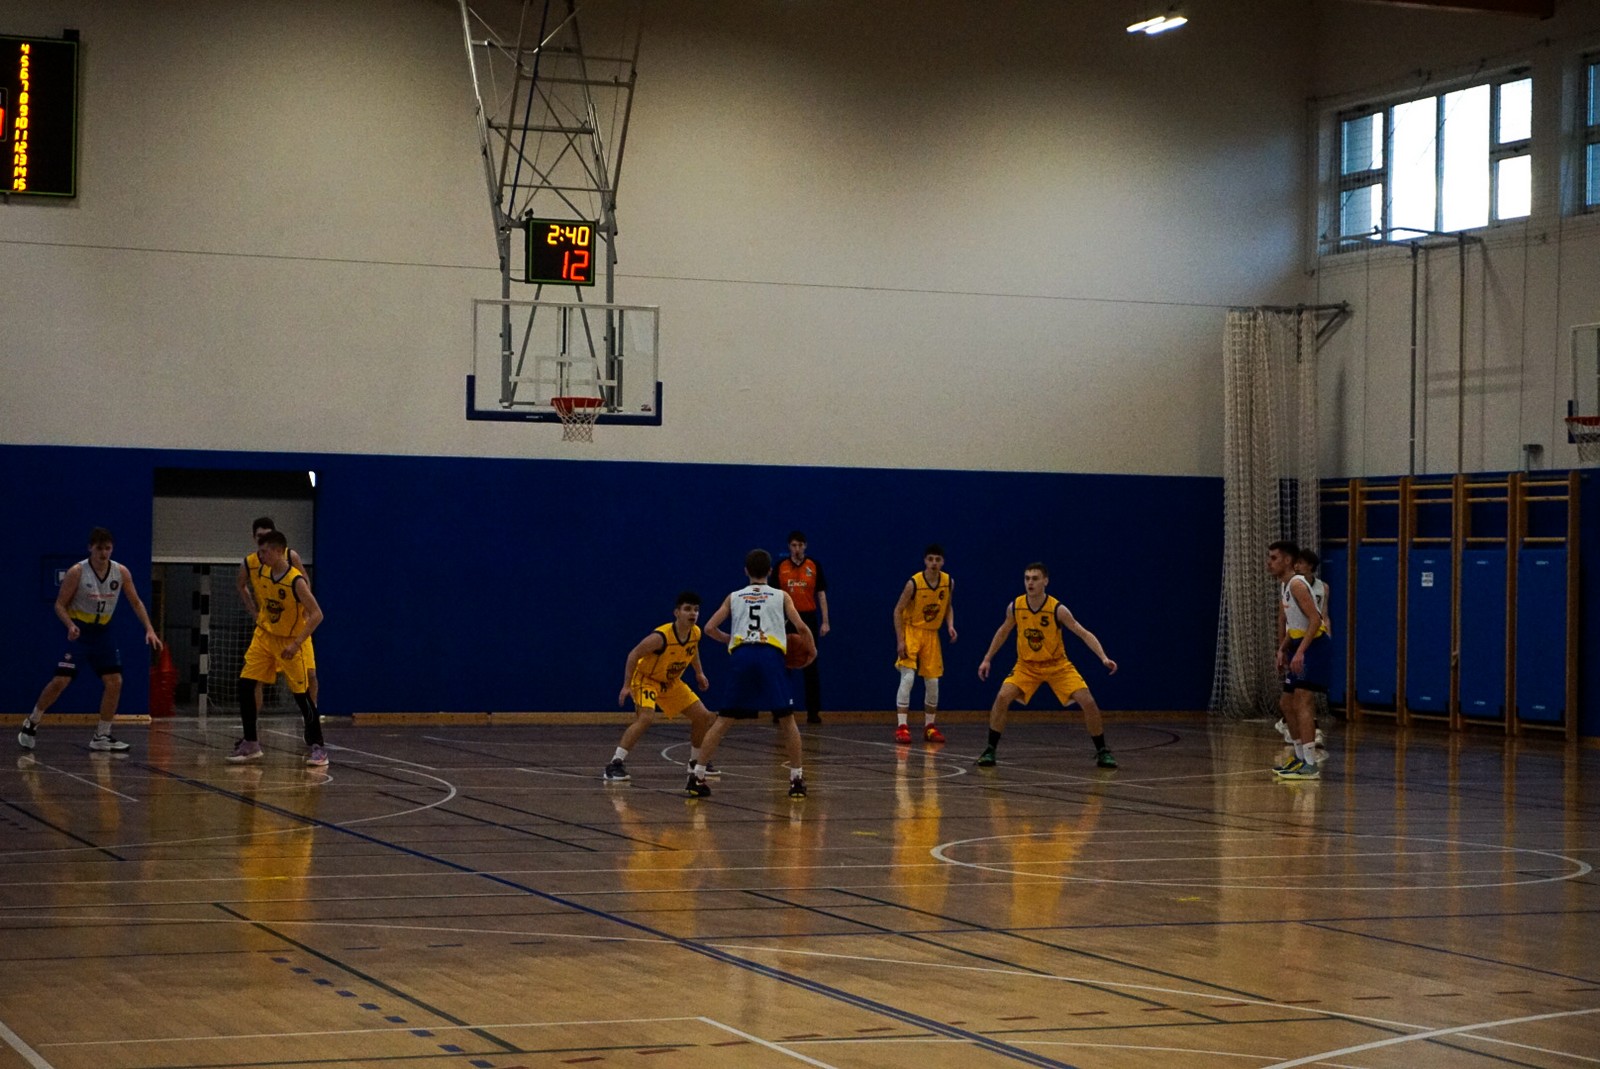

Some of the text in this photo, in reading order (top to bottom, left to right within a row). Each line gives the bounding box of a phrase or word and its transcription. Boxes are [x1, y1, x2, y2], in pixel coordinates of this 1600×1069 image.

[20, 43, 31, 55] 4
[20, 55, 30, 68] 5
[19, 68, 30, 80] 6
[21, 80, 30, 92] 7
[19, 92, 29, 104] 8
[19, 104, 29, 116] 9
[15, 116, 29, 129] 10
[14, 129, 29, 141] 11
[14, 141, 28, 153] 12
[14, 153, 28, 165] 13
[13, 165, 28, 177] 14
[13, 177, 27, 191] 15
[547, 224, 590, 246] 2:40
[562, 249, 589, 281] 12
[96, 601, 106, 613] 17
[748, 605, 761, 630] 5
[1040, 615, 1050, 627] 5
[643, 690, 656, 701] 10
